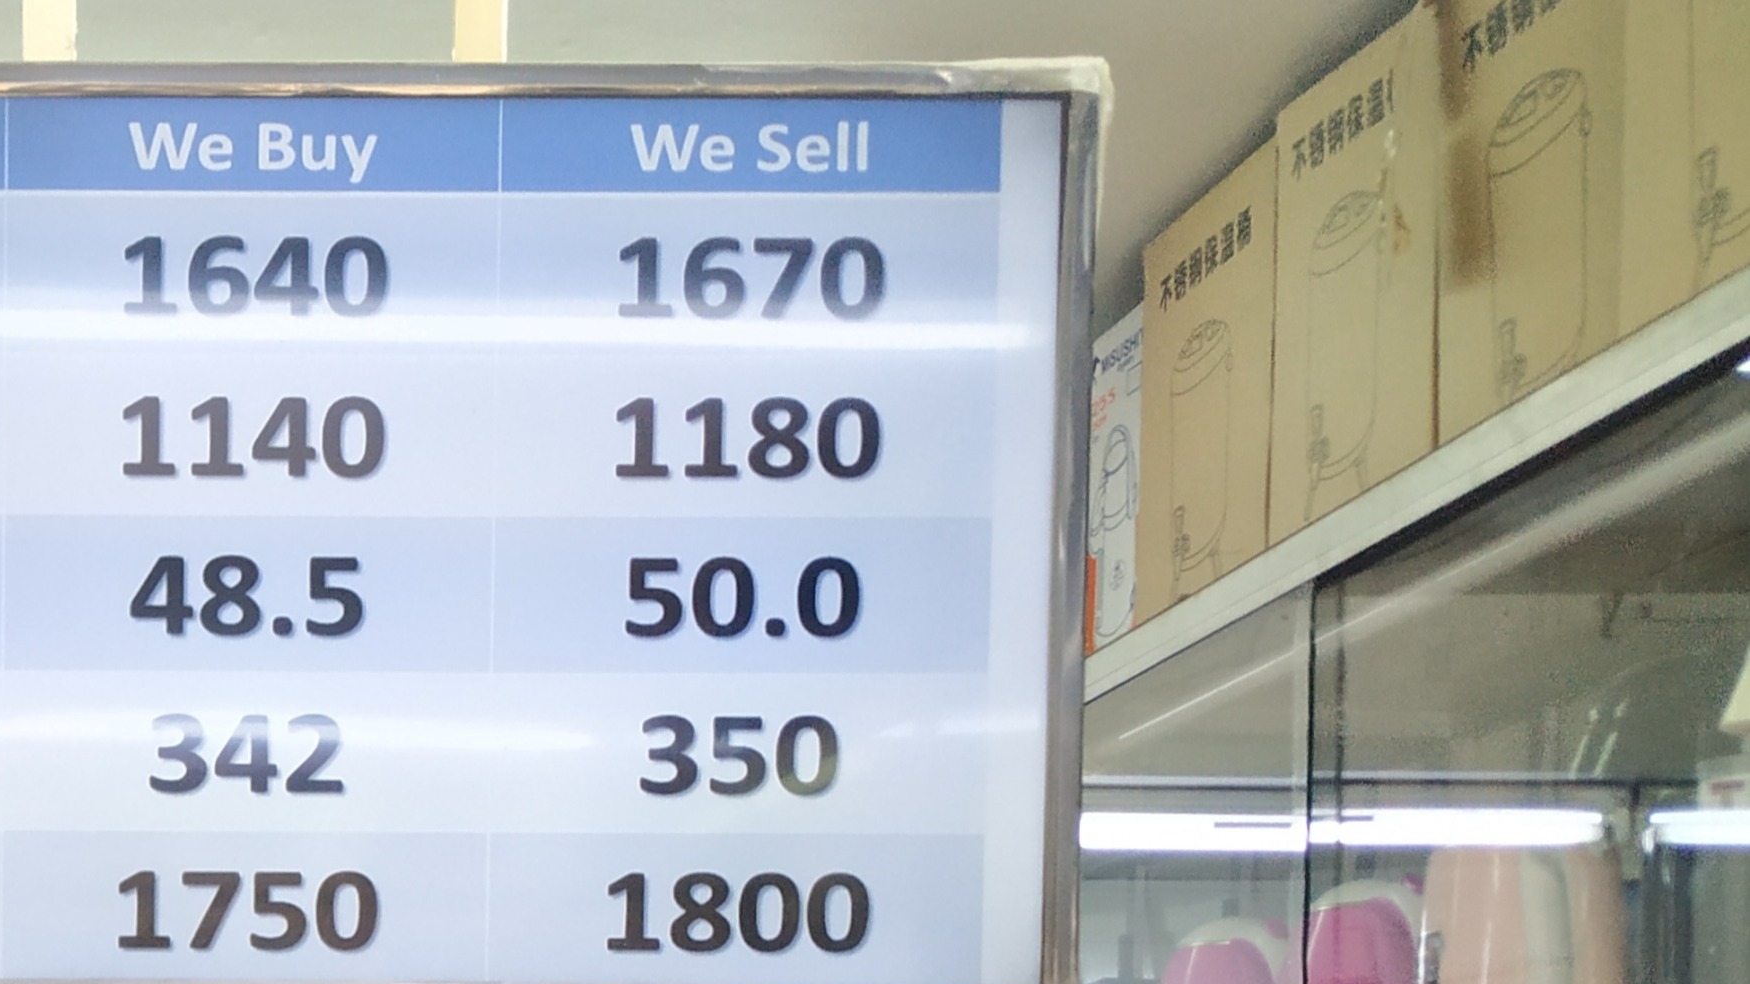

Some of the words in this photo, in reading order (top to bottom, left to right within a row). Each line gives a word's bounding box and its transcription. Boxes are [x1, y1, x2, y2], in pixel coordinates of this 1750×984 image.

[1461, 0, 1558, 73] 不锈钢
[128, 120, 234, 172] We
[256, 121, 379, 183] Buy
[630, 122, 735, 173] We
[756, 120, 870, 173] Sell
[122, 234, 390, 318] 1640
[617, 235, 886, 320] 1670
[121, 393, 387, 480] 1140
[614, 395, 881, 479] 1180
[129, 553, 365, 637] 48.5
[624, 556, 862, 639] 50.0
[148, 712, 345, 795] 342
[638, 713, 840, 798] 350
[117, 869, 380, 952] 1750
[605, 871, 872, 954] 1800
